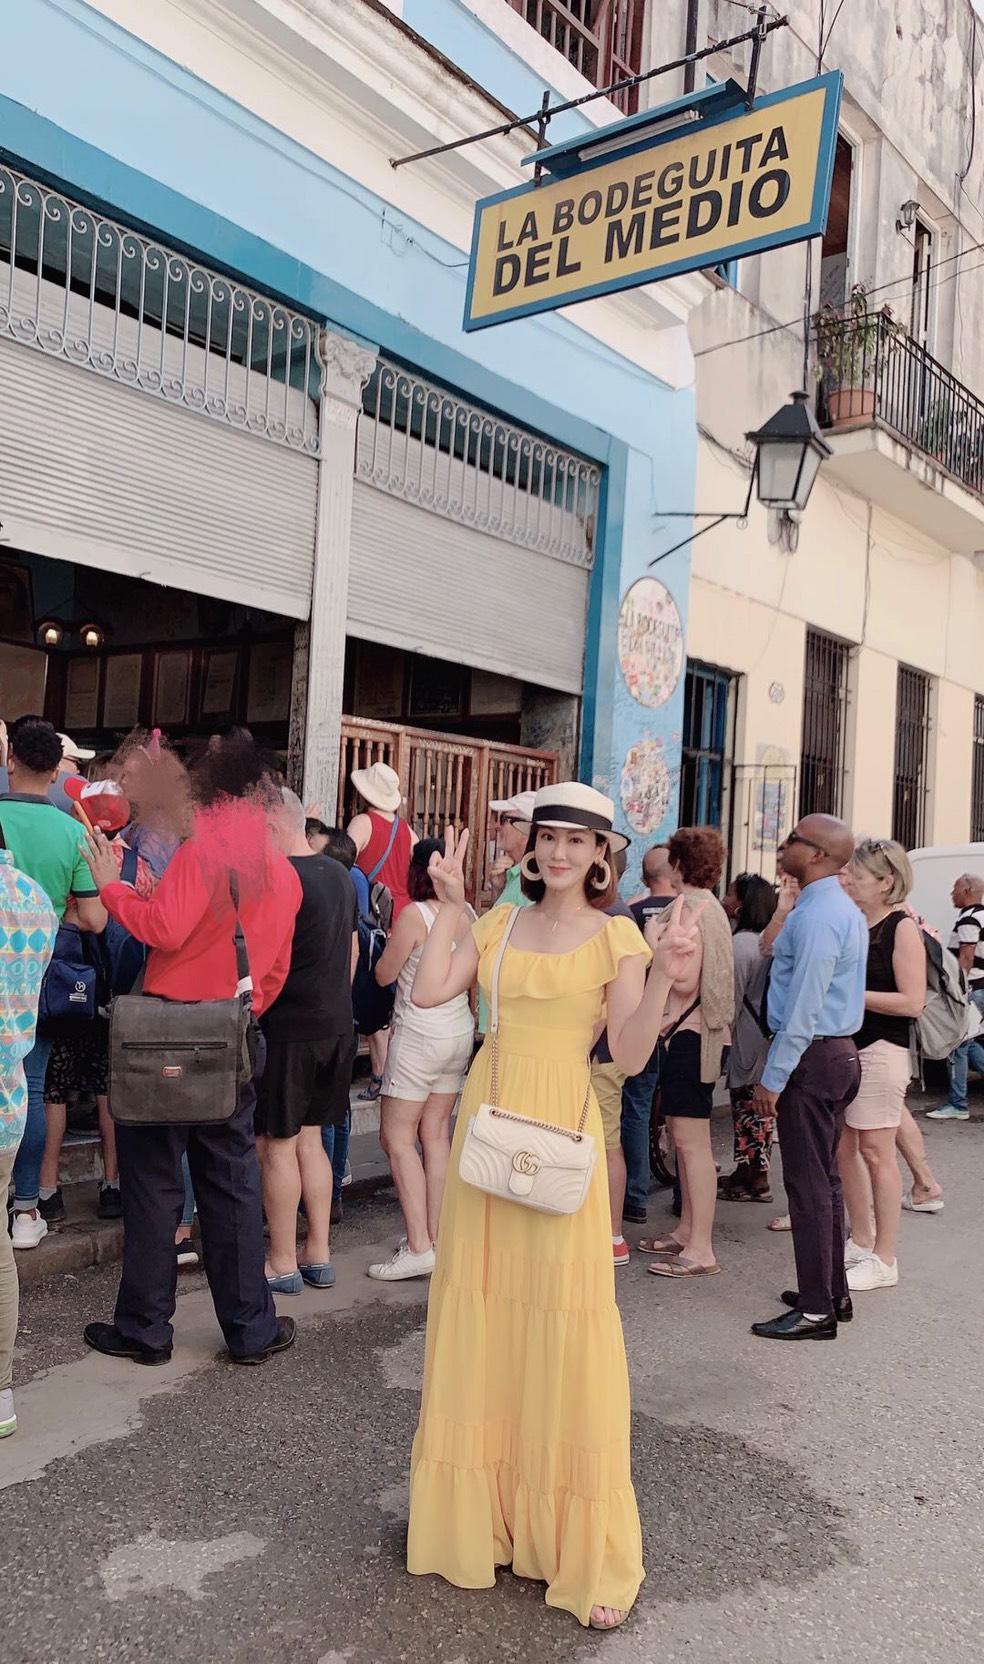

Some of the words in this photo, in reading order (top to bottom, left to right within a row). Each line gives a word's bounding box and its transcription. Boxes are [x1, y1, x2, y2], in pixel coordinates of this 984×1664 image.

[492, 236, 582, 297] DEL
[604, 168, 791, 265] MEDIO
[497, 211, 539, 253] LA
[552, 126, 791, 236] BODEGUITA
